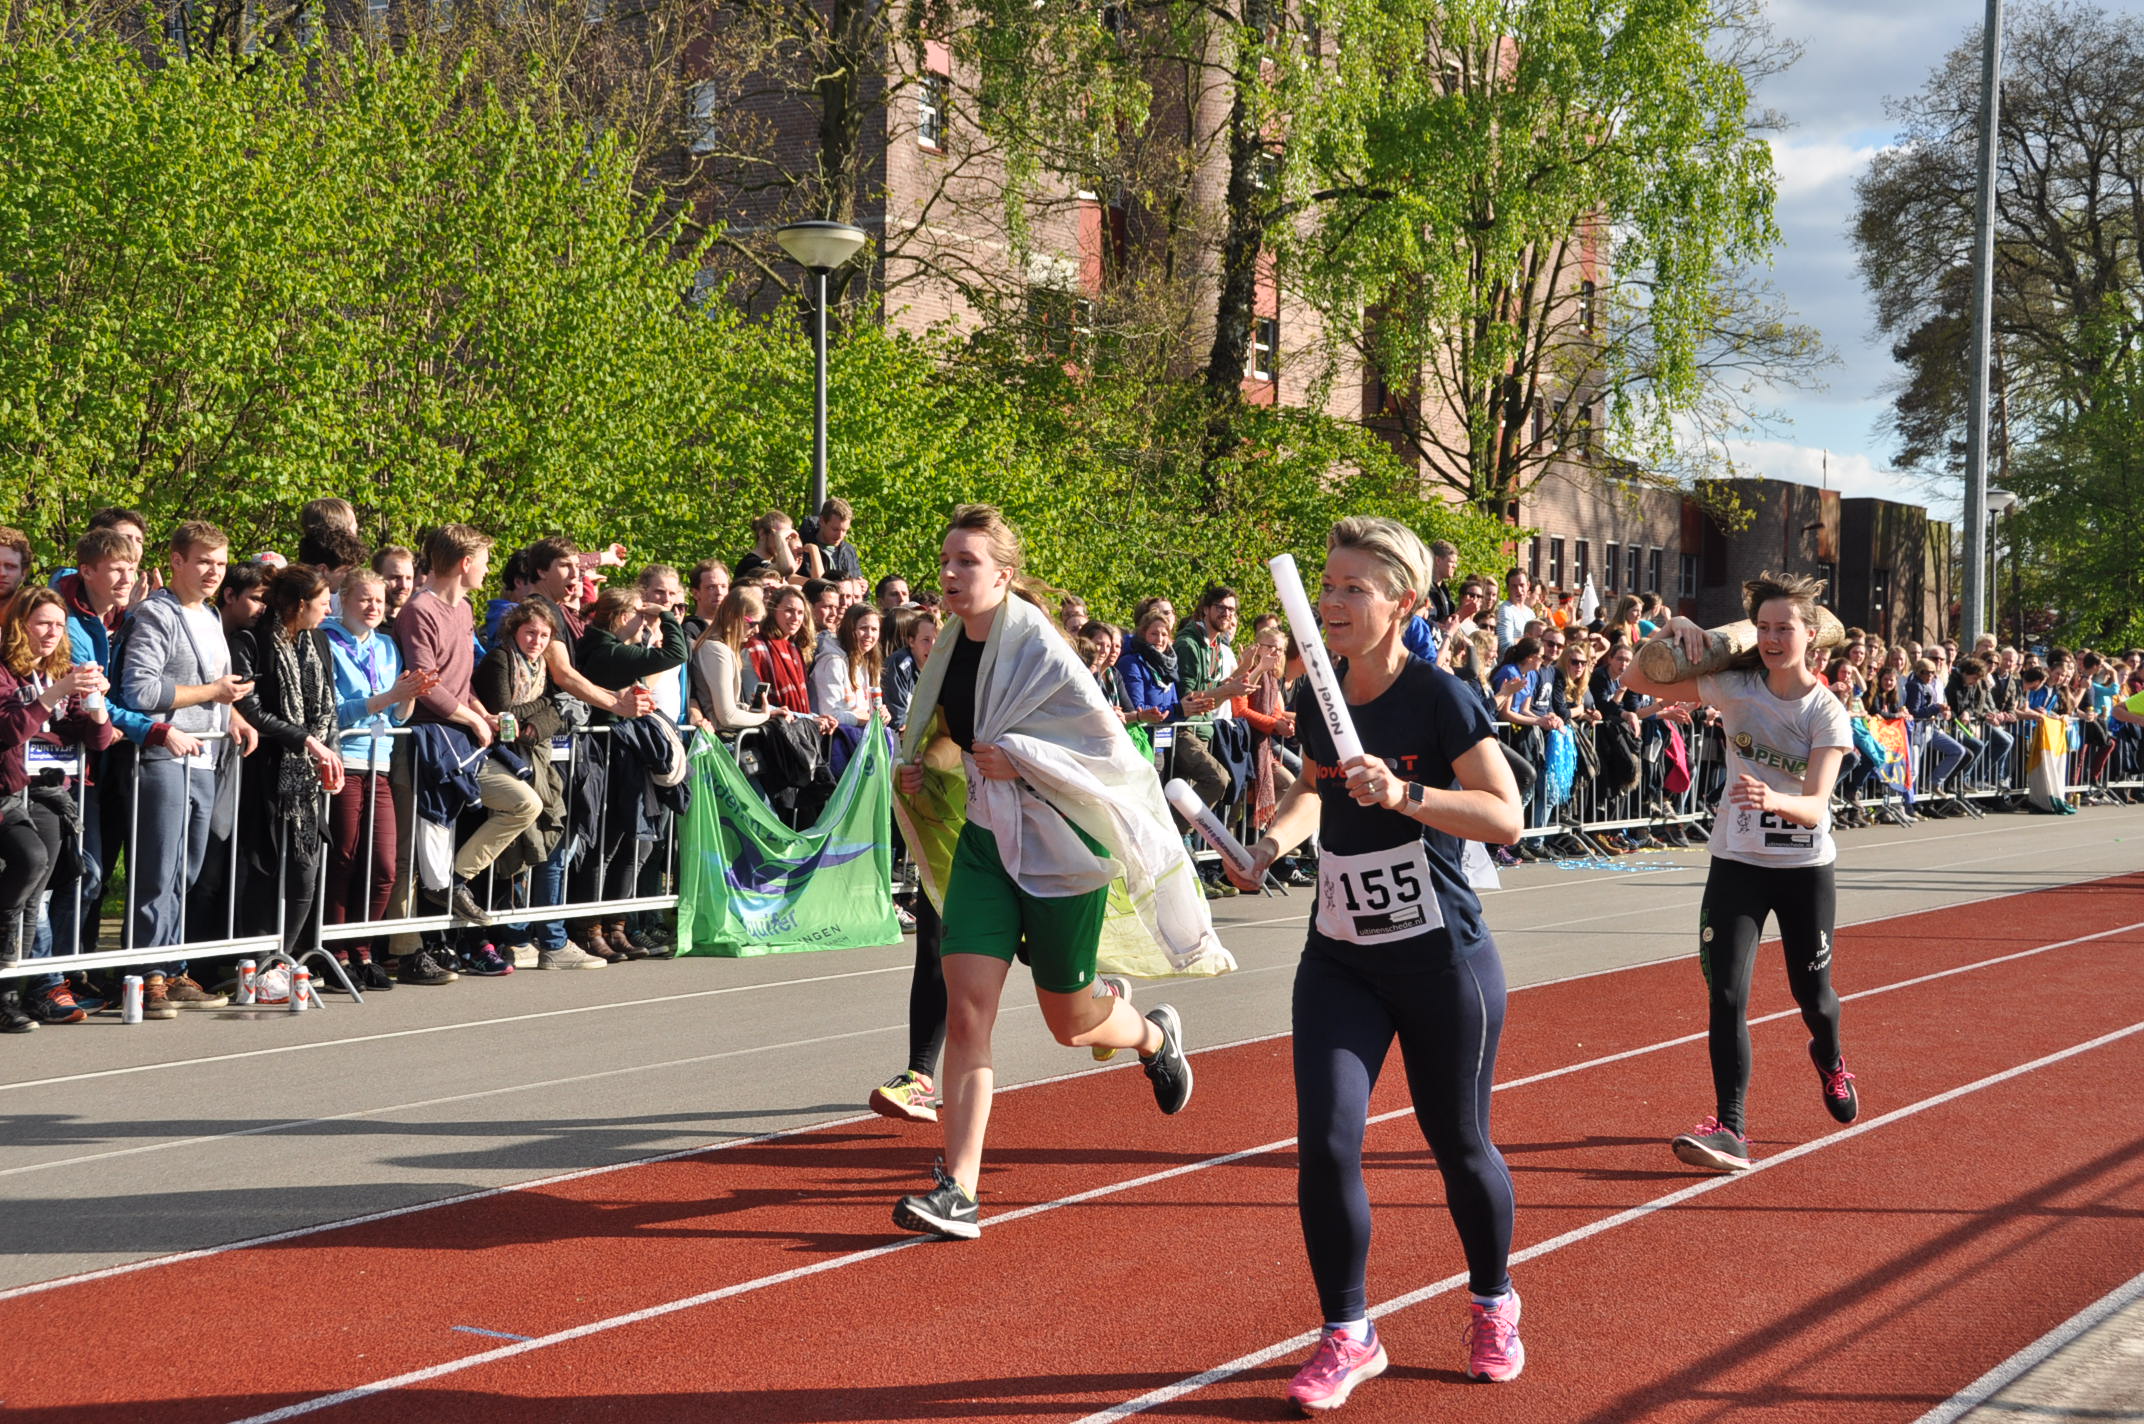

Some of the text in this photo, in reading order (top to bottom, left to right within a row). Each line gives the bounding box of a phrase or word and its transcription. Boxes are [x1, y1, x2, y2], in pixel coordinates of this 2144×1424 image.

[1317, 686, 1343, 735] Novel
[1340, 861, 1422, 911] 155
[1360, 918, 1423, 936] uitinenschede.nl
